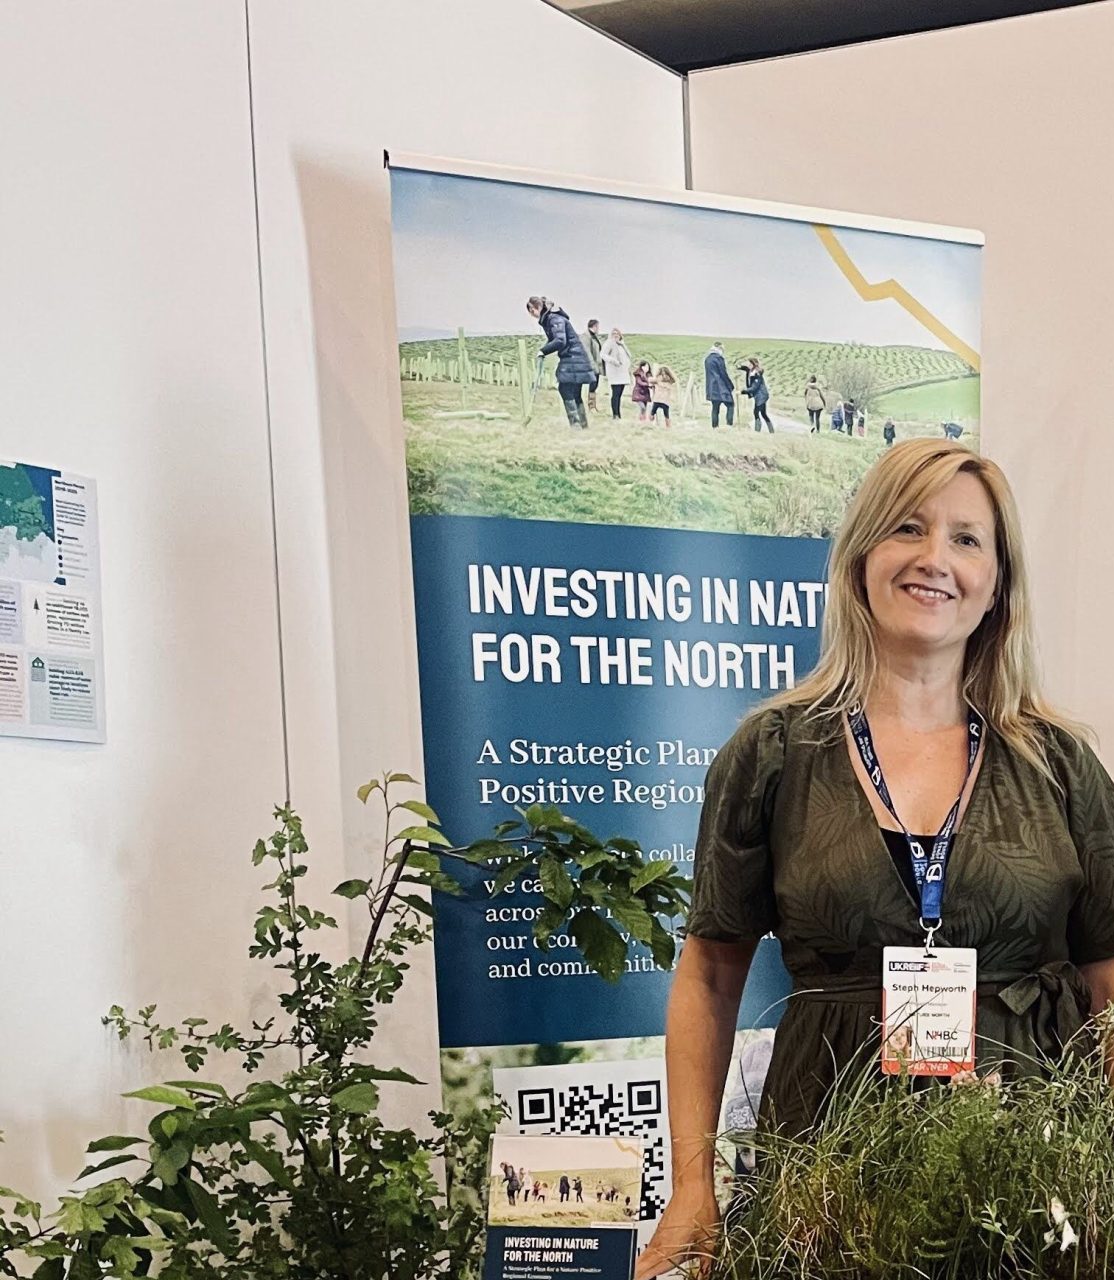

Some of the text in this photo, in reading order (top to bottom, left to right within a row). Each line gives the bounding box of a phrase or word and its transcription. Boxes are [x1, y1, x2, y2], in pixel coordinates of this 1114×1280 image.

[467, 564, 829, 628] INVESTING IN NAT
[471, 632, 796, 690] FOR THE NORTH
[476, 740, 718, 772] A Strategic Plan
[479, 778, 605, 804] Positive
[487, 933, 528, 951] our
[488, 958, 532, 979] and
[892, 983, 967, 994] Steph Hepworth
[926, 1030, 958, 1041] NHBC
[505, 1237, 599, 1249] INVESTING IN NATURE
[504, 1250, 573, 1262] FOR THE NORTH
